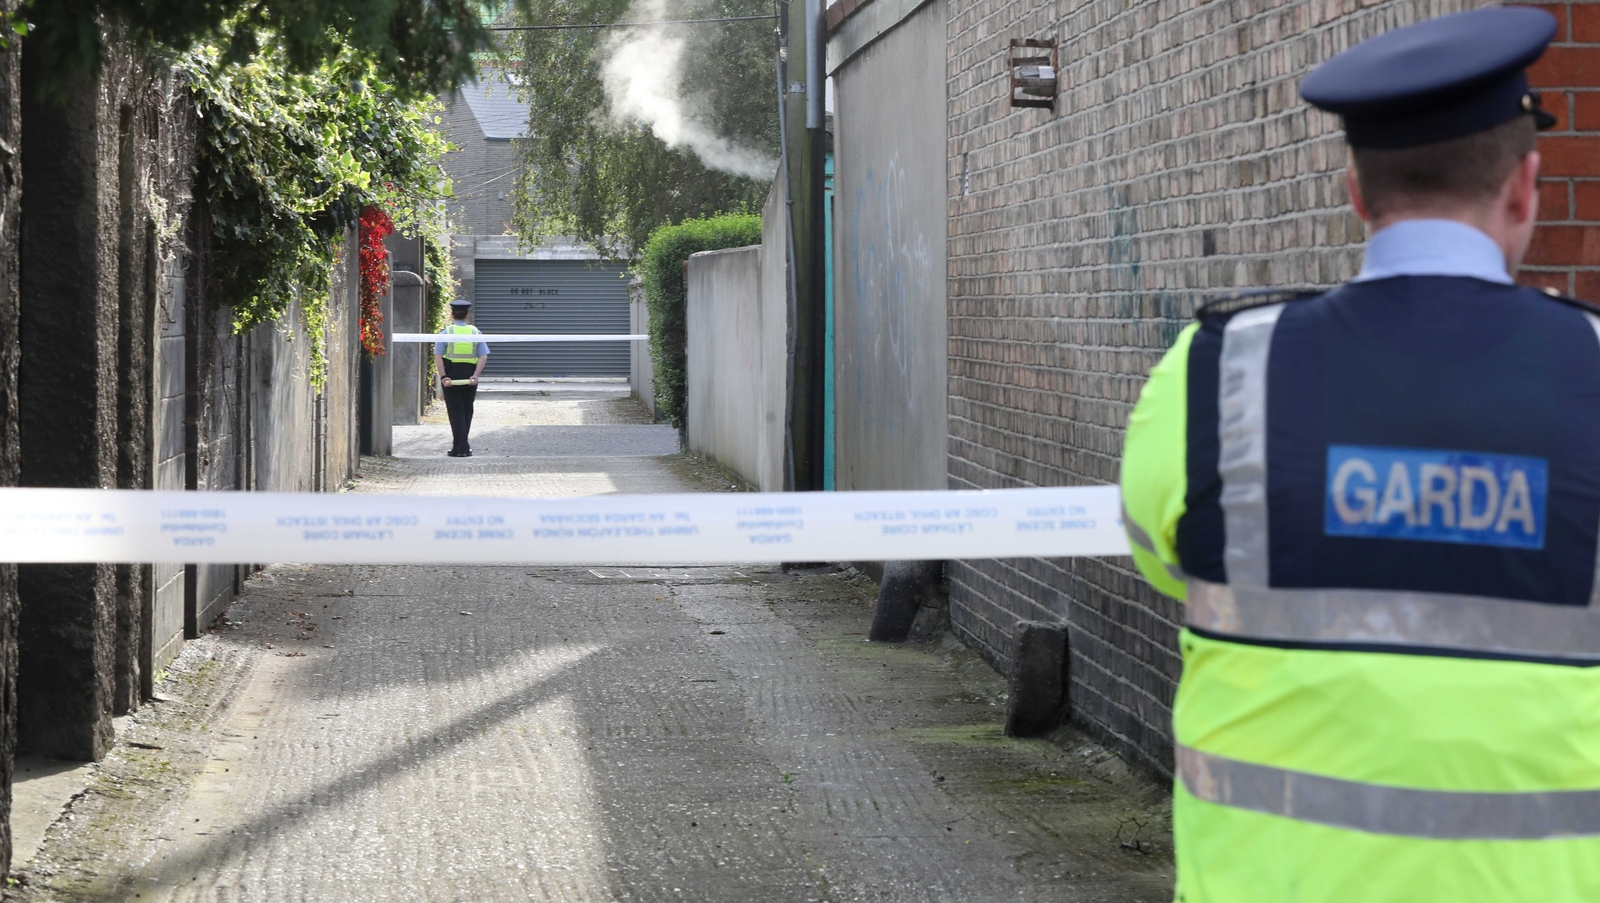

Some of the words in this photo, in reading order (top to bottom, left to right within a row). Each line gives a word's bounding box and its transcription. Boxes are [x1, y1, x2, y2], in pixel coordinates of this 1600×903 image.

[1332, 457, 1536, 535] GARDA
[944, 509, 961, 519] AR
[1027, 505, 1066, 517] ENTRY
[1068, 505, 1087, 516] NO
[365, 516, 382, 526] AR
[446, 515, 484, 526] ENTRY
[487, 515, 505, 525] NO
[603, 512, 647, 523] GARDA
[648, 512, 666, 522] AN
[160, 522, 228, 533] Confidential
[736, 519, 804, 530] Confidential
[1015, 520, 1056, 531] SCENE
[1059, 519, 1097, 530] CRIME
[434, 529, 474, 540] SCENE
[477, 529, 514, 539] CRIME
[749, 533, 792, 544] GARDA
[172, 536, 215, 547] GARDA
